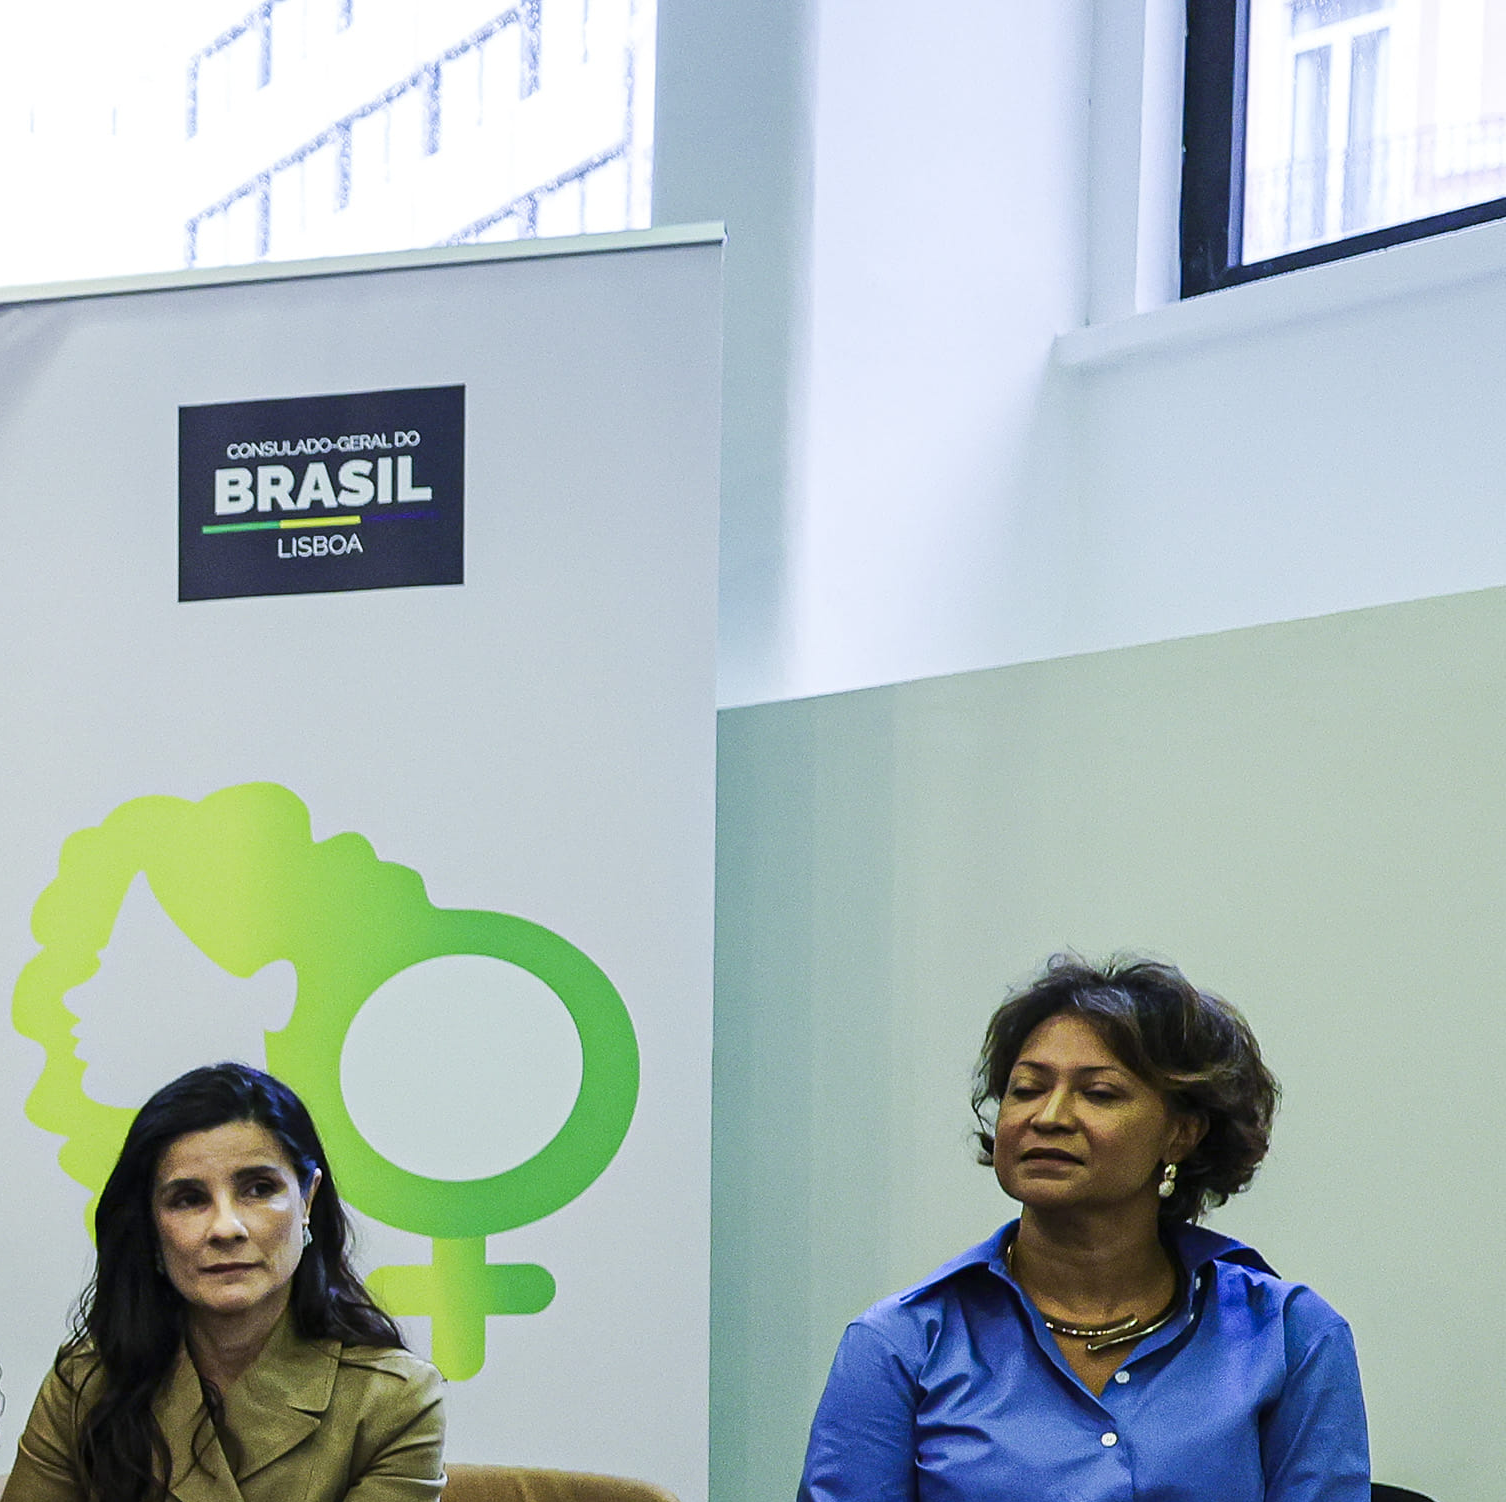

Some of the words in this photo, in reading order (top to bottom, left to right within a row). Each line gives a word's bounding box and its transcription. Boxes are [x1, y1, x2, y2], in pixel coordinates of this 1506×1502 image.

[227, 433, 392, 460] CONSULADO-GERAL
[394, 430, 421, 447] DO
[214, 455, 433, 516] BRASIL
[277, 533, 364, 559] LISBOA
